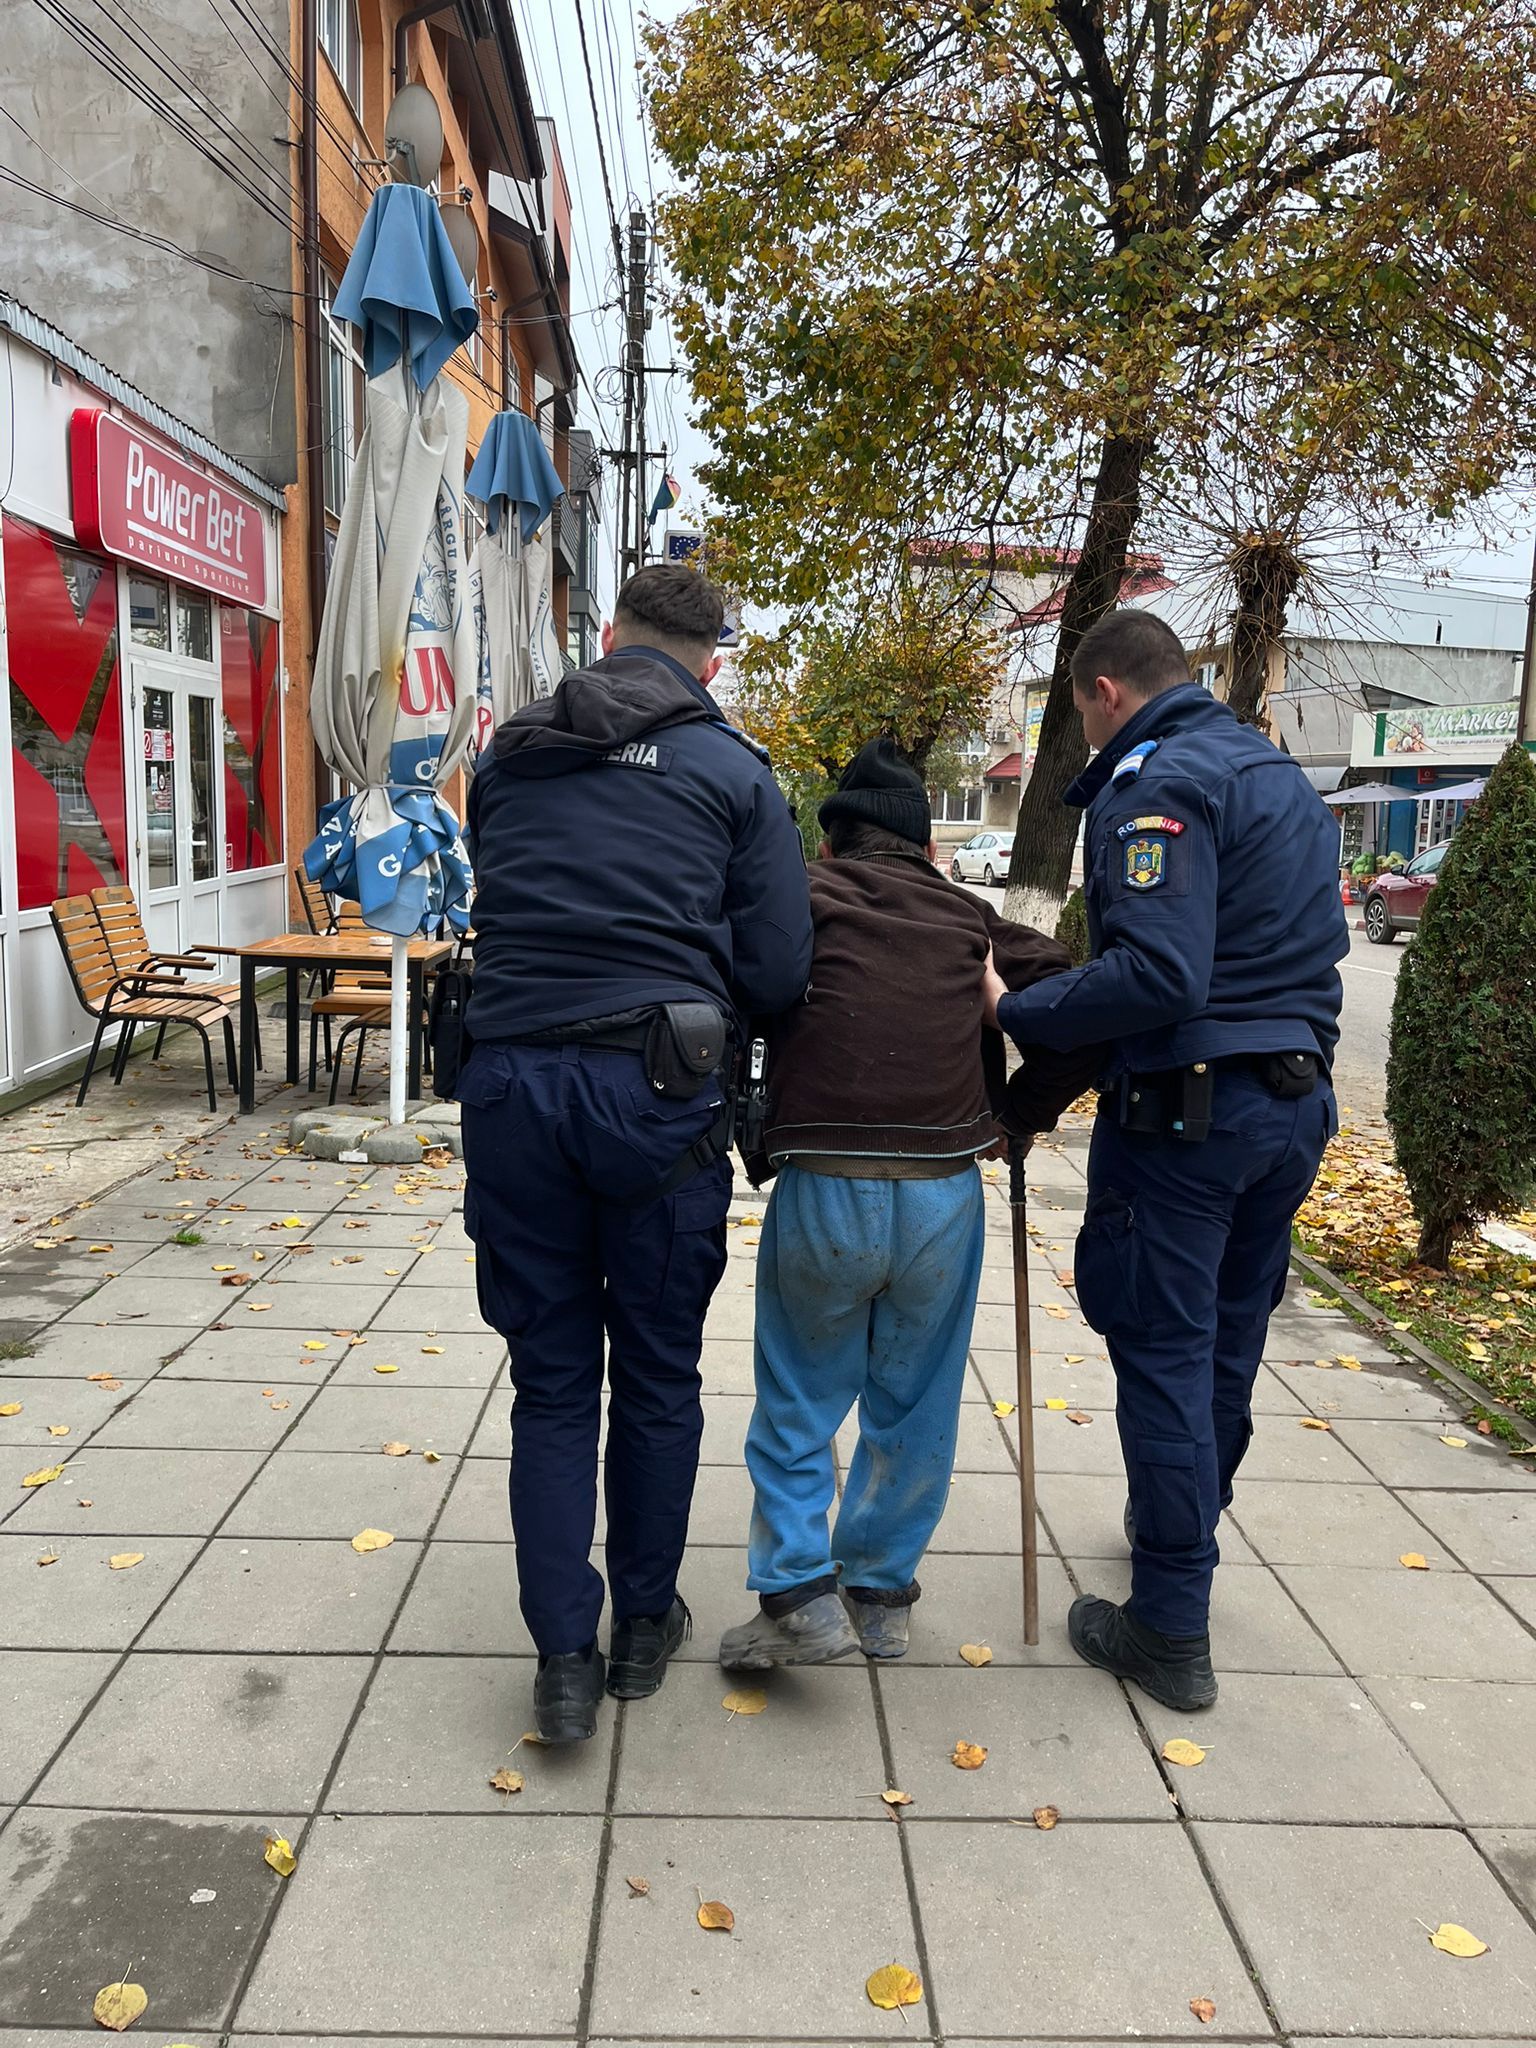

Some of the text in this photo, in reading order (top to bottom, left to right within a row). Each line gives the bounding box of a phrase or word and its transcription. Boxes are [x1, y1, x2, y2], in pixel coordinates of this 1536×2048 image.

[128, 535, 250, 594] pariuri sportive
[1434, 711, 1519, 732] MARKET
[604, 742, 658, 767] ERIA
